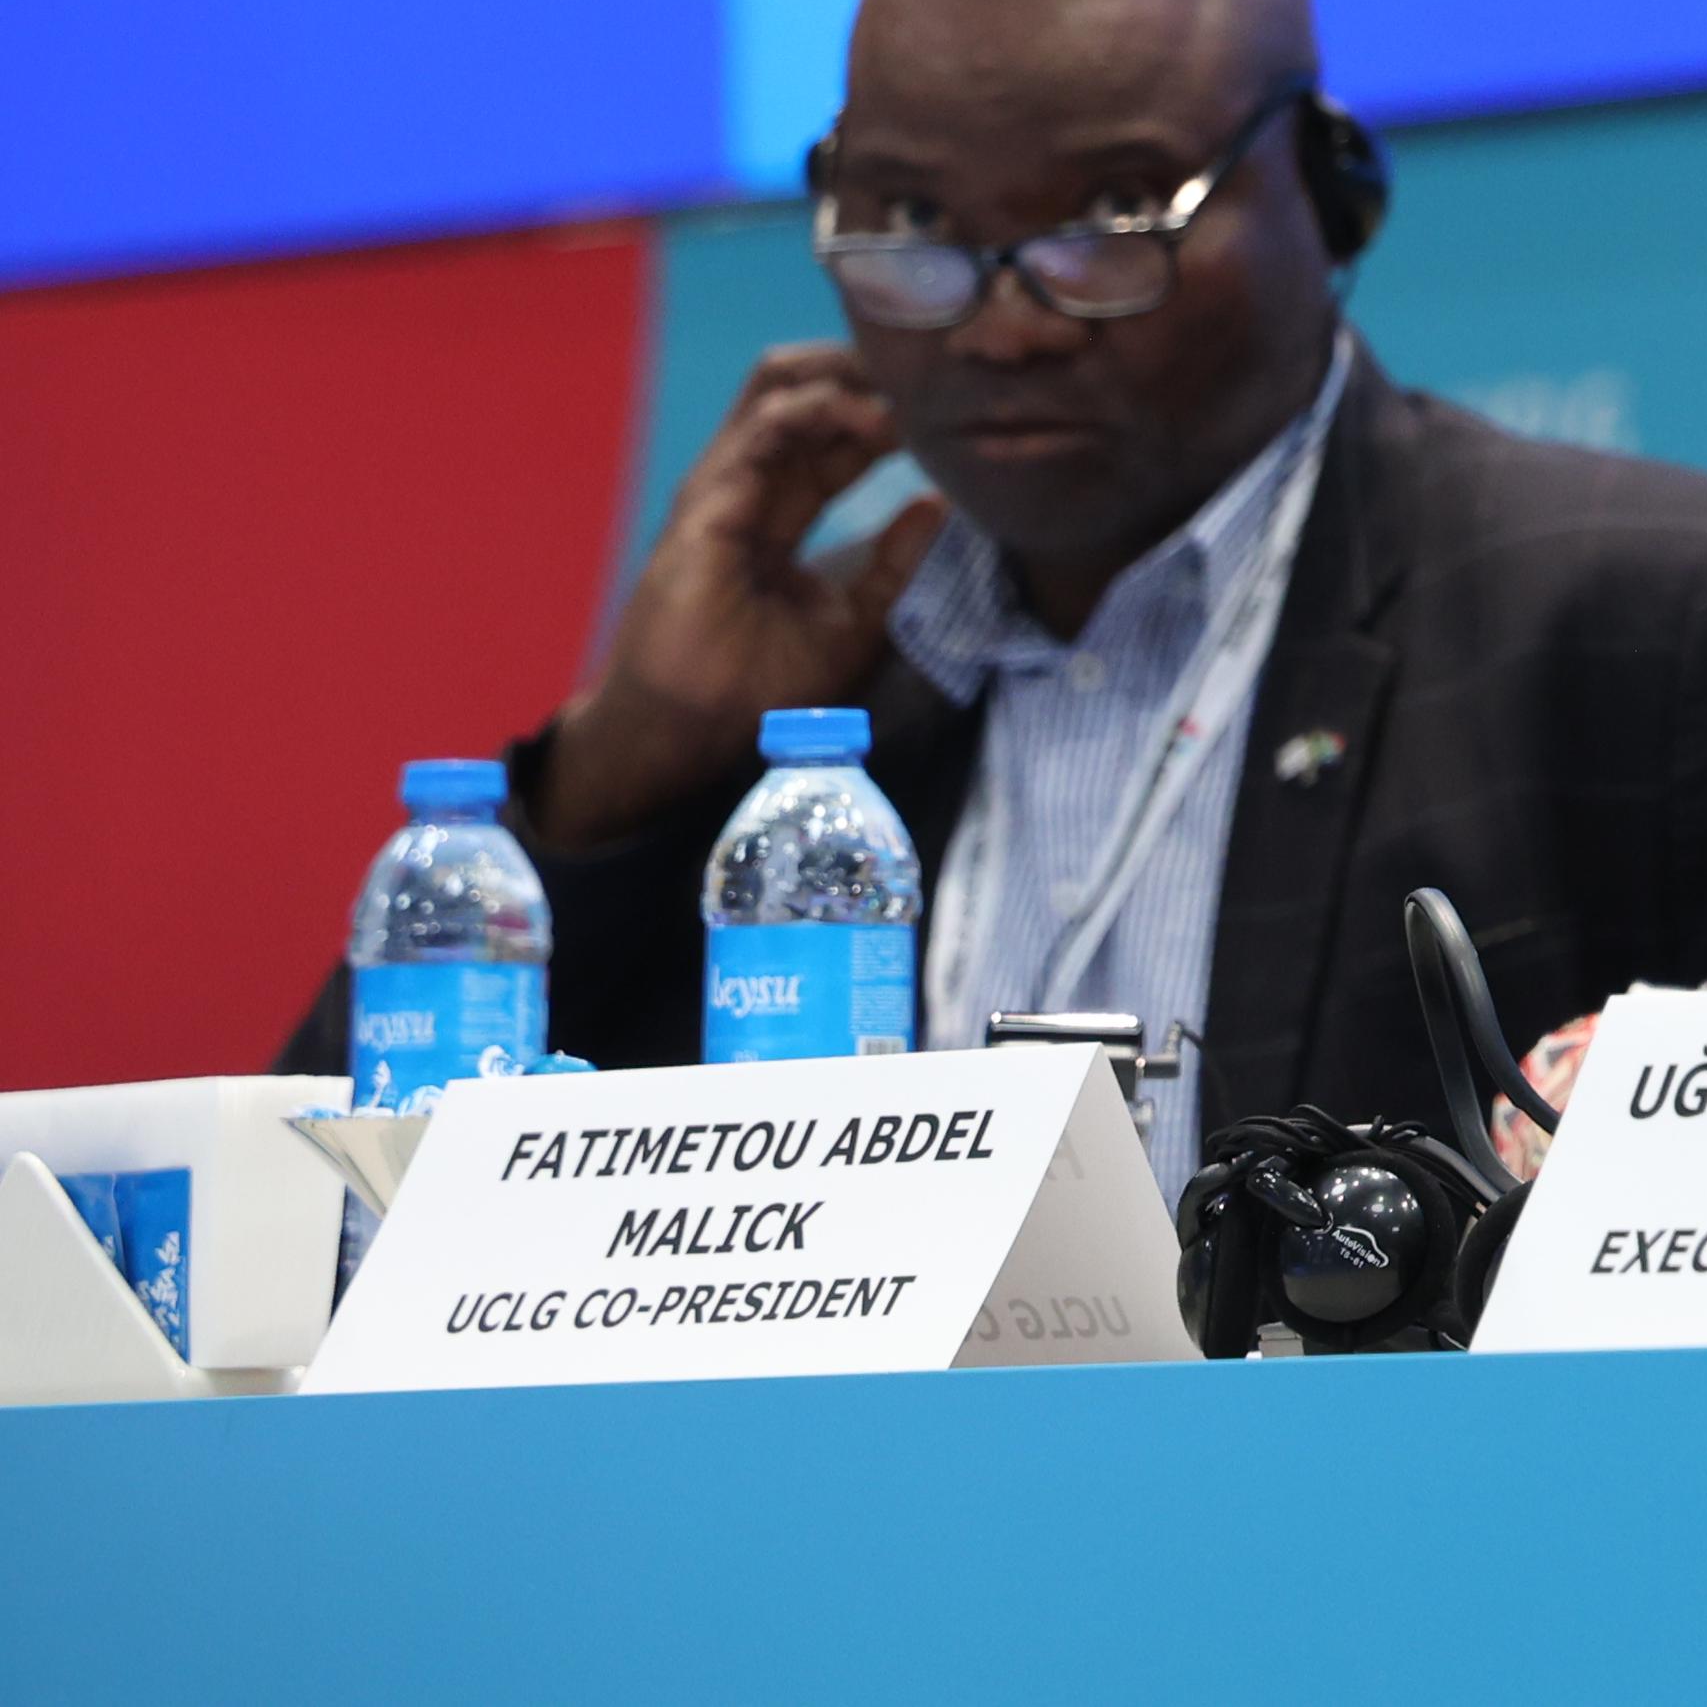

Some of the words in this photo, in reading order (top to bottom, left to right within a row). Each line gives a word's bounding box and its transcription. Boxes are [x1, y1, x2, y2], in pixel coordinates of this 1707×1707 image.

[501, 1119, 818, 1181] FATIMETOU
[819, 1109, 994, 1167] ABDEL
[605, 1201, 825, 1259] MALICK
[446, 1290, 568, 1334] UCLG
[573, 1275, 917, 1329] CO-PRESIDENT
